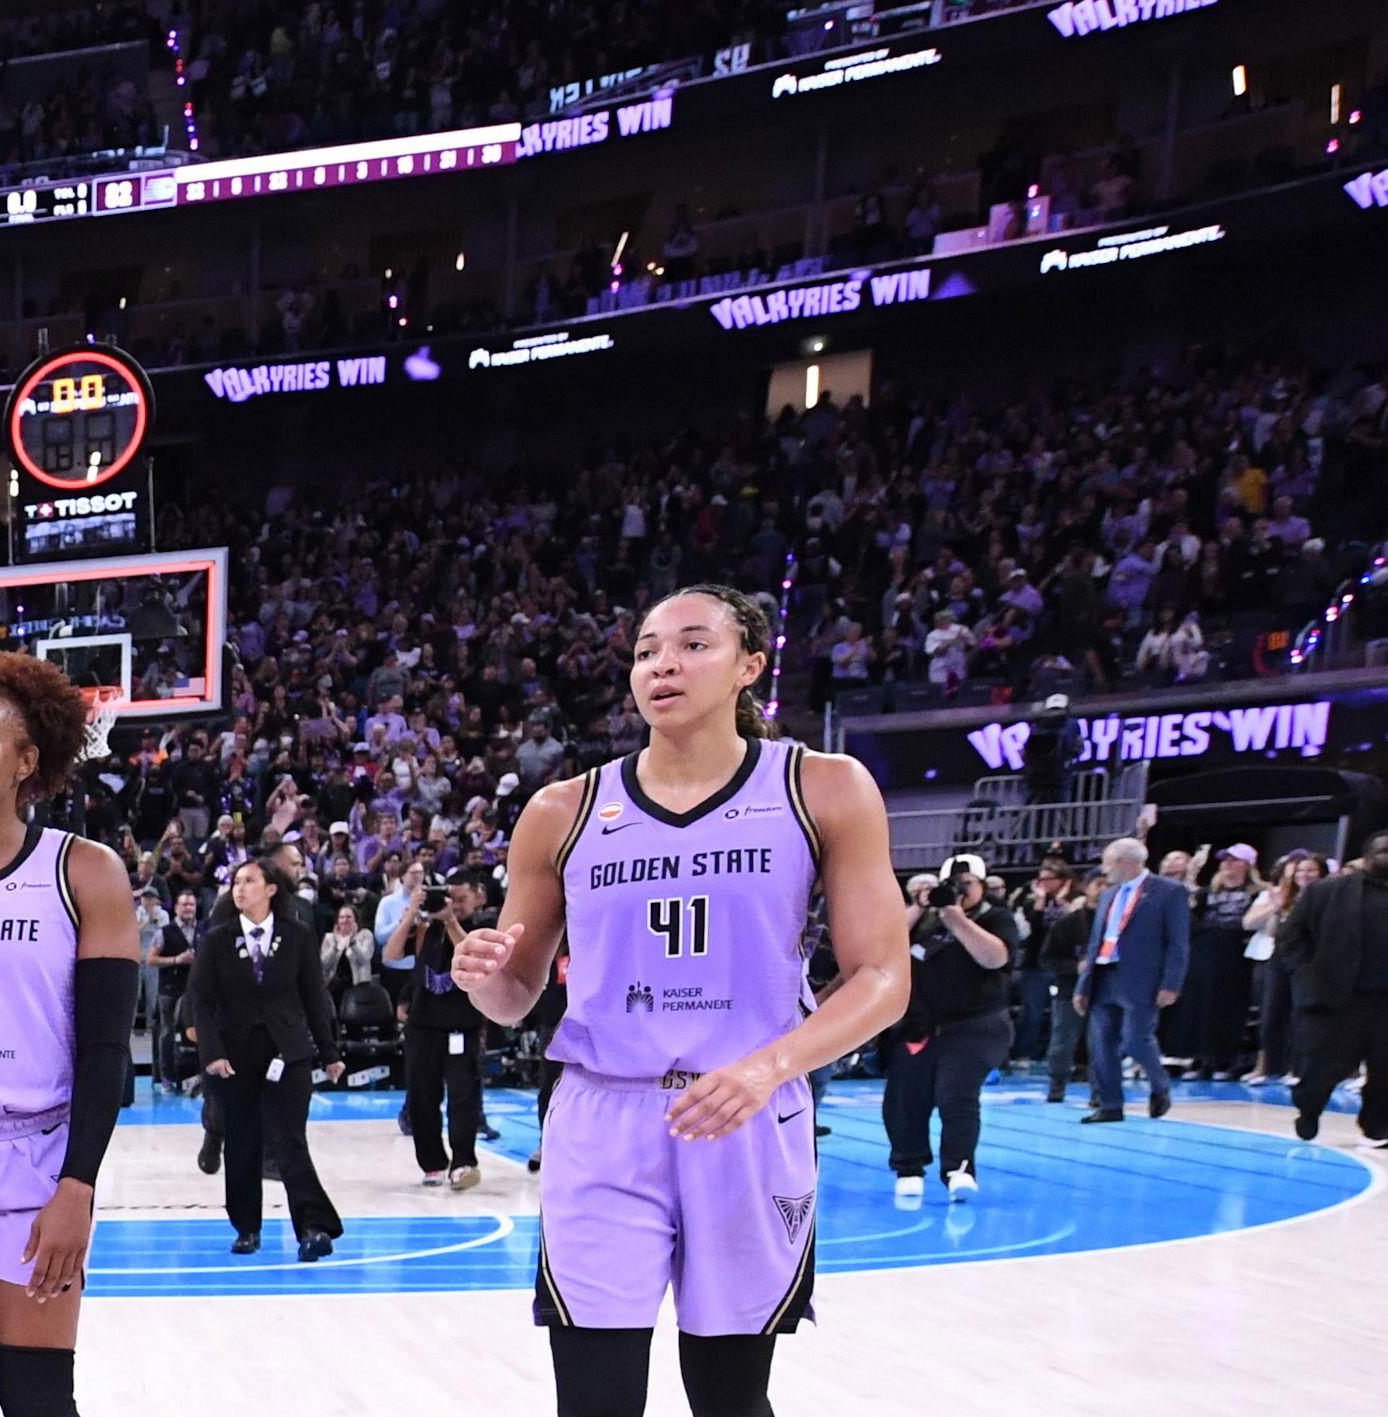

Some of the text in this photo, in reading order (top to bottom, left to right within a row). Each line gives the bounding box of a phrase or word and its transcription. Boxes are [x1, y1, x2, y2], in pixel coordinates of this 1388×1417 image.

[617, 98, 672, 135] WIN
[711, 269, 931, 330] VALKYRIES WIN
[205, 356, 385, 398] VALKYRIES WIN
[54, 492, 137, 517] TISSOT
[1229, 702, 1330, 752] WIN
[590, 848, 772, 890] GOLDEN STATE
[647, 895, 709, 958] 41
[662, 987, 703, 998] KAISER
